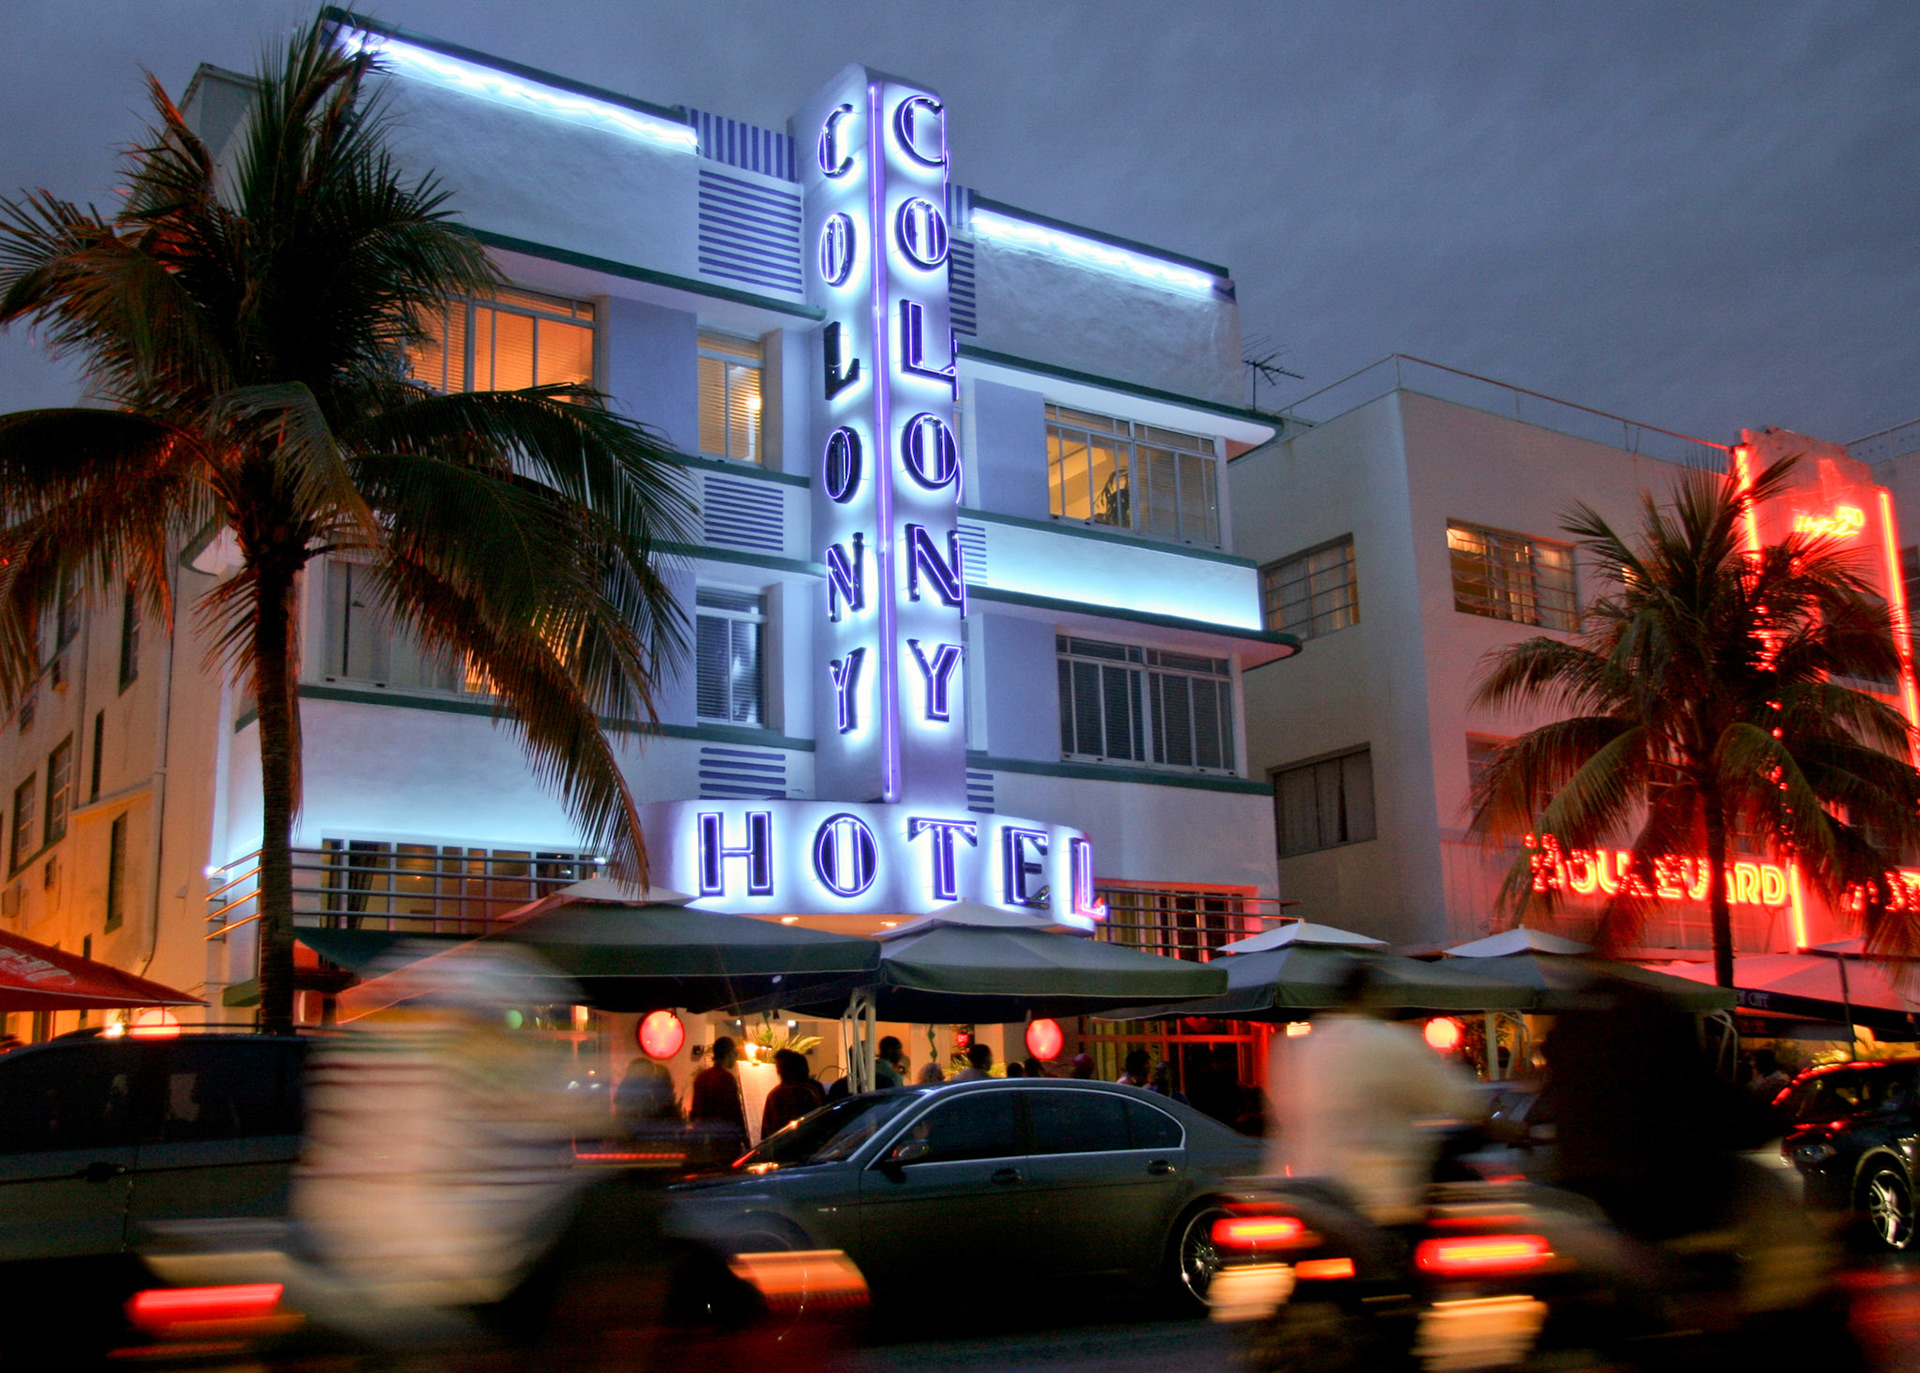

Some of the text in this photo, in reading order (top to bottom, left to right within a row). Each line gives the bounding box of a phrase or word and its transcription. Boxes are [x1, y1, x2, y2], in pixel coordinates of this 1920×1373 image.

[817, 103, 867, 735] COLONY
[893, 95, 968, 722] COLONY
[697, 810, 1107, 921] HOTEL
[1525, 833, 1788, 906] OUEVRD
